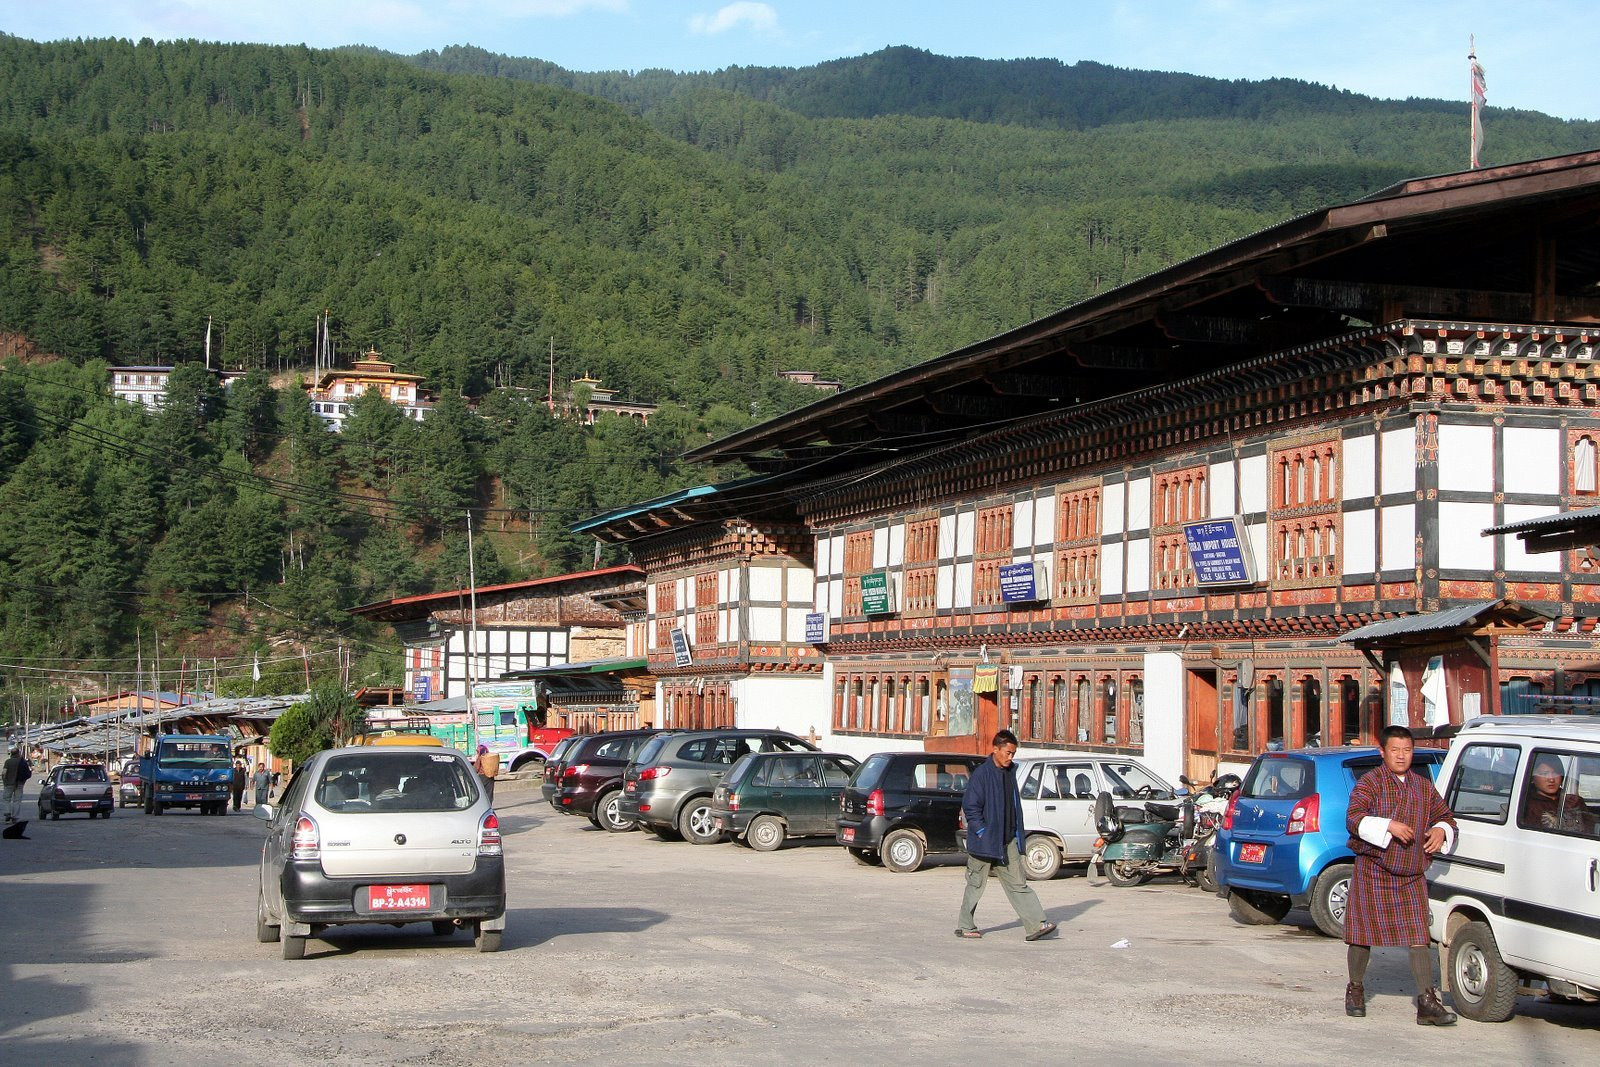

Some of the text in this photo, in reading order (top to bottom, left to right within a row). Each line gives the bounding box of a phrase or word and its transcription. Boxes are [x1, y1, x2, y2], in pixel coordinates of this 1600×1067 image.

[1202, 540, 1220, 550] IMPORT
[1221, 538, 1238, 548] HOUSE
[1214, 572, 1226, 580] SALE
[1228, 571, 1241, 580] SALE
[372, 897, 427, 908] BP-2-A4314
